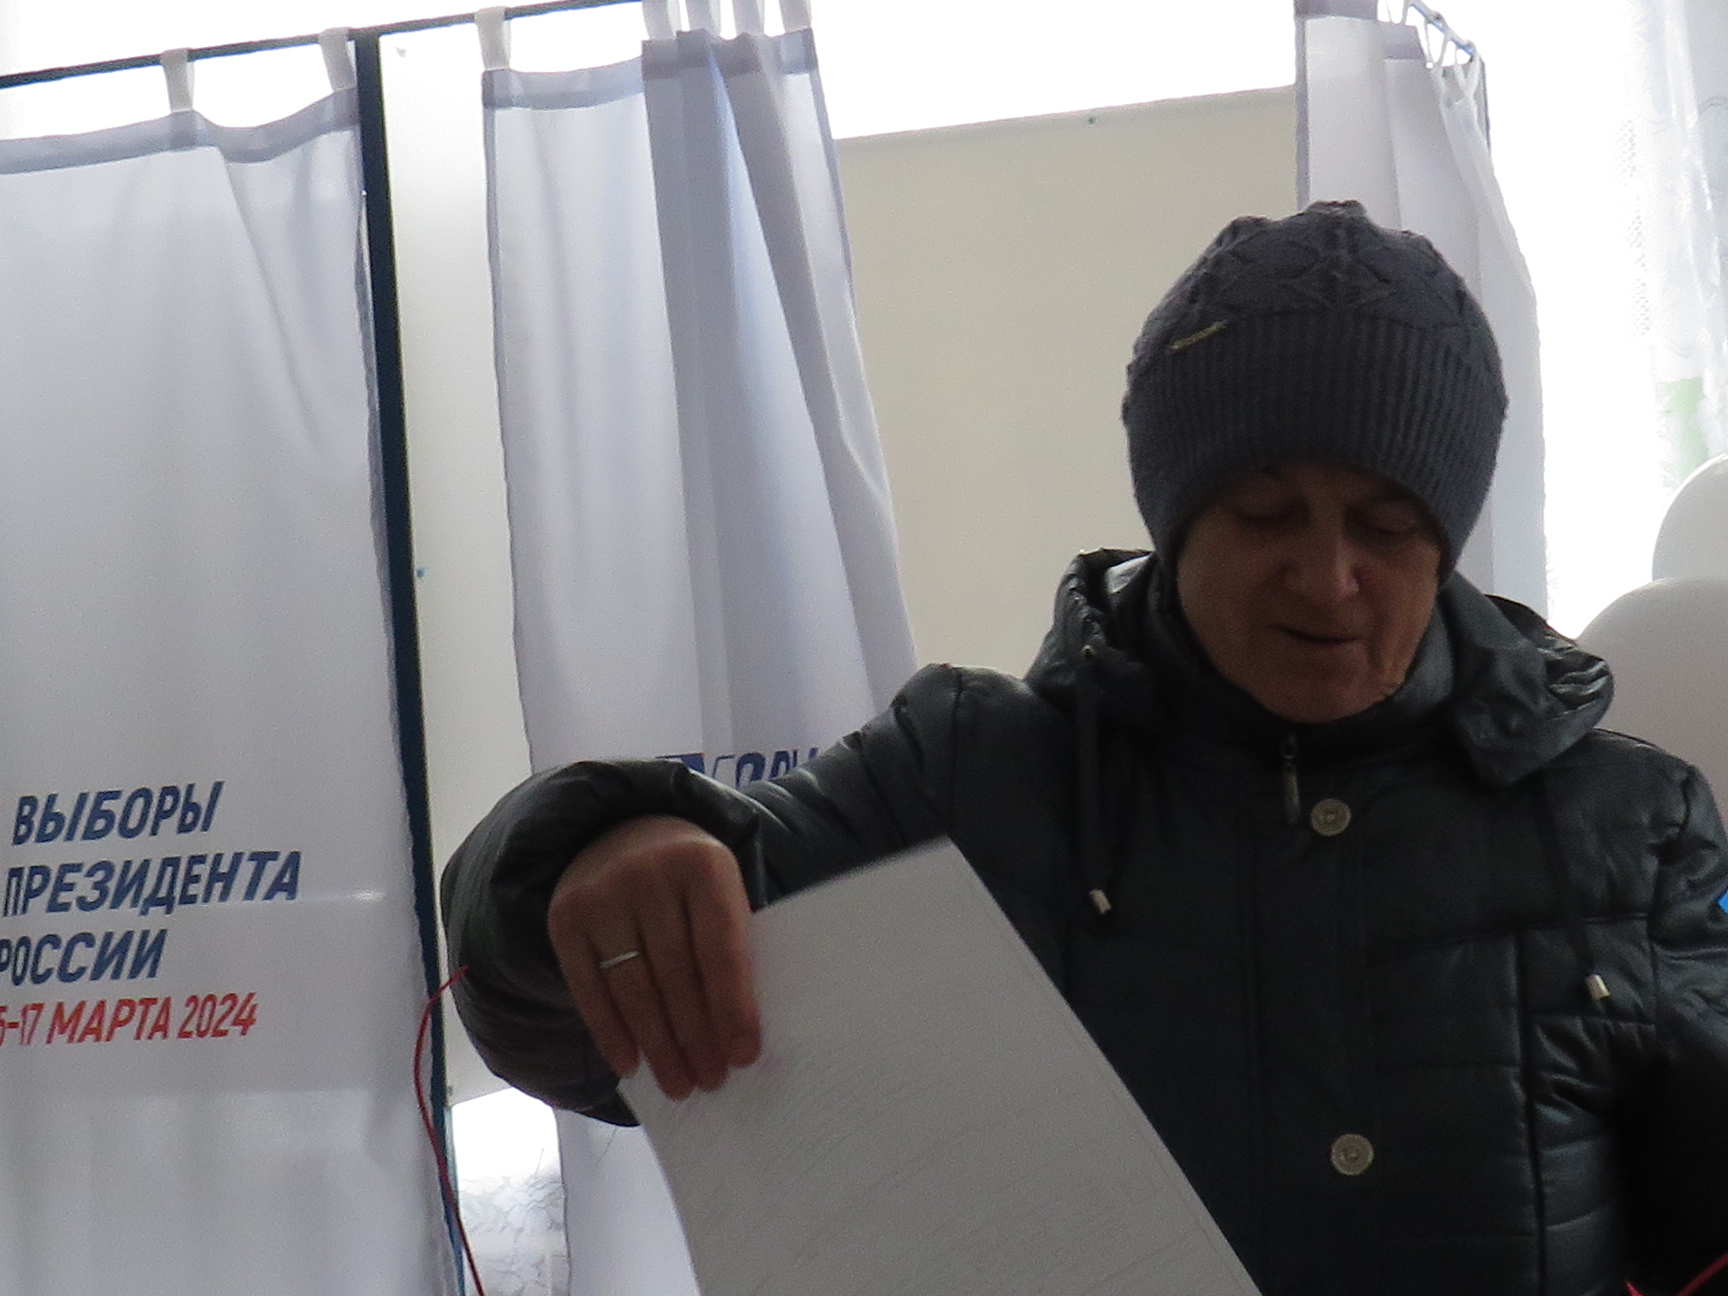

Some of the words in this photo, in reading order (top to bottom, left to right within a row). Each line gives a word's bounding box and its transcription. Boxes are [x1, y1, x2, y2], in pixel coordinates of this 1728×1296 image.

[11, 780, 226, 846] ВЫБОРЫ
[1, 850, 304, 918] ПРЕЗИДЕНТА
[46, 995, 172, 1045] МАРТА
[176, 991, 258, 1040] 2024
